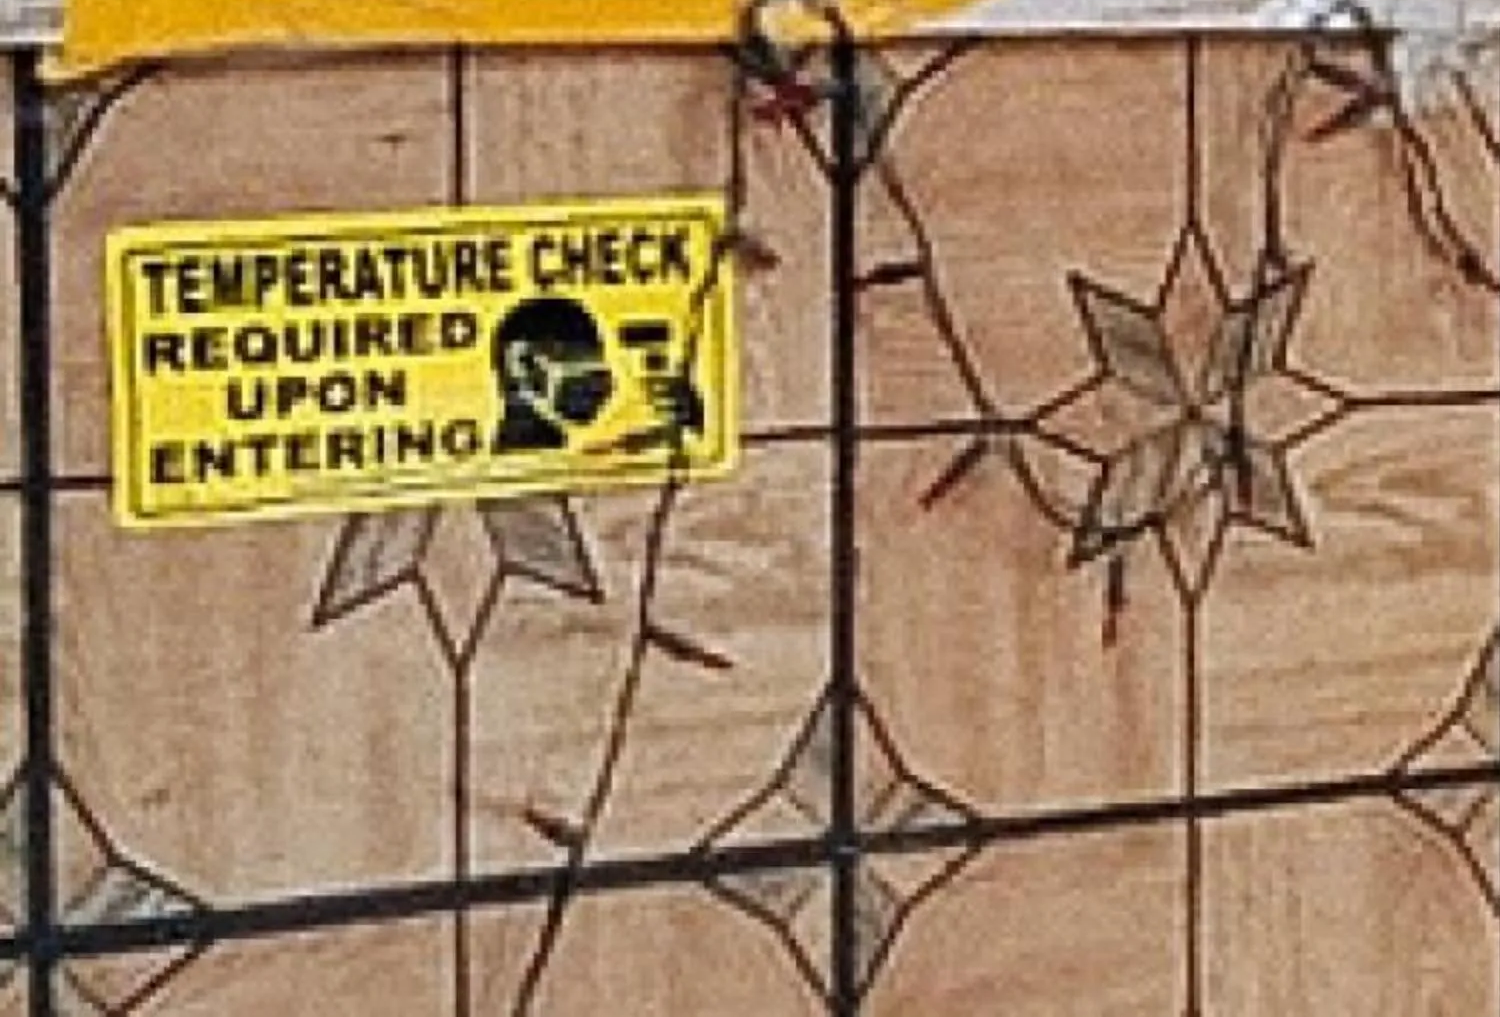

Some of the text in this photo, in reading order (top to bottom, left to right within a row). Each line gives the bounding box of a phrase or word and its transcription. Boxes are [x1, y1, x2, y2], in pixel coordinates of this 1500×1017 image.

[142, 230, 694, 313] TEMPERATURE CHECK
[144, 311, 479, 374] REQUIRED
[227, 370, 406, 420] UPON
[150, 419, 480, 485] ENTERING
